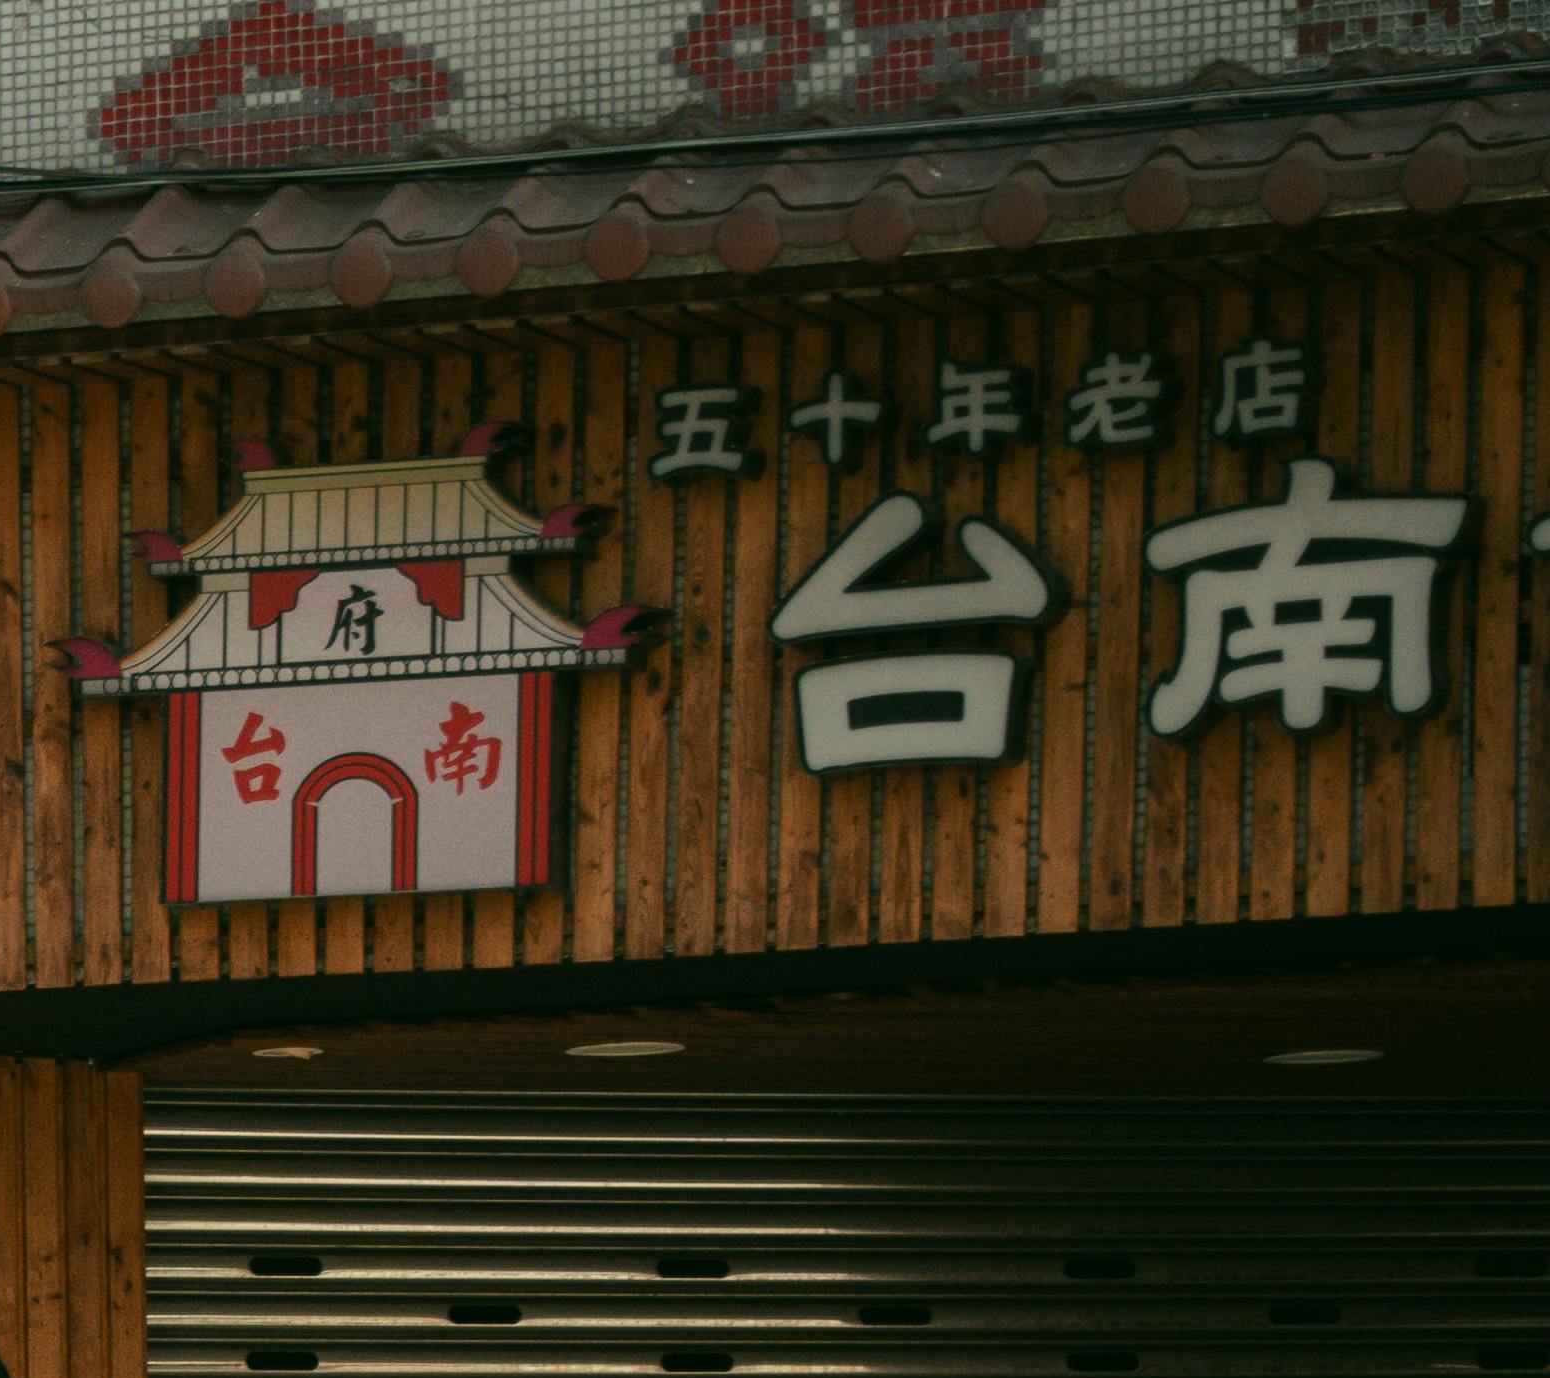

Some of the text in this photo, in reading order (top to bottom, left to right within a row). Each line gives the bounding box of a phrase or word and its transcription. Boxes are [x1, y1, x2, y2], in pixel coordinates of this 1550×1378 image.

[652, 339, 1308, 478] 五十年老店
[324, 585, 385, 658] 府
